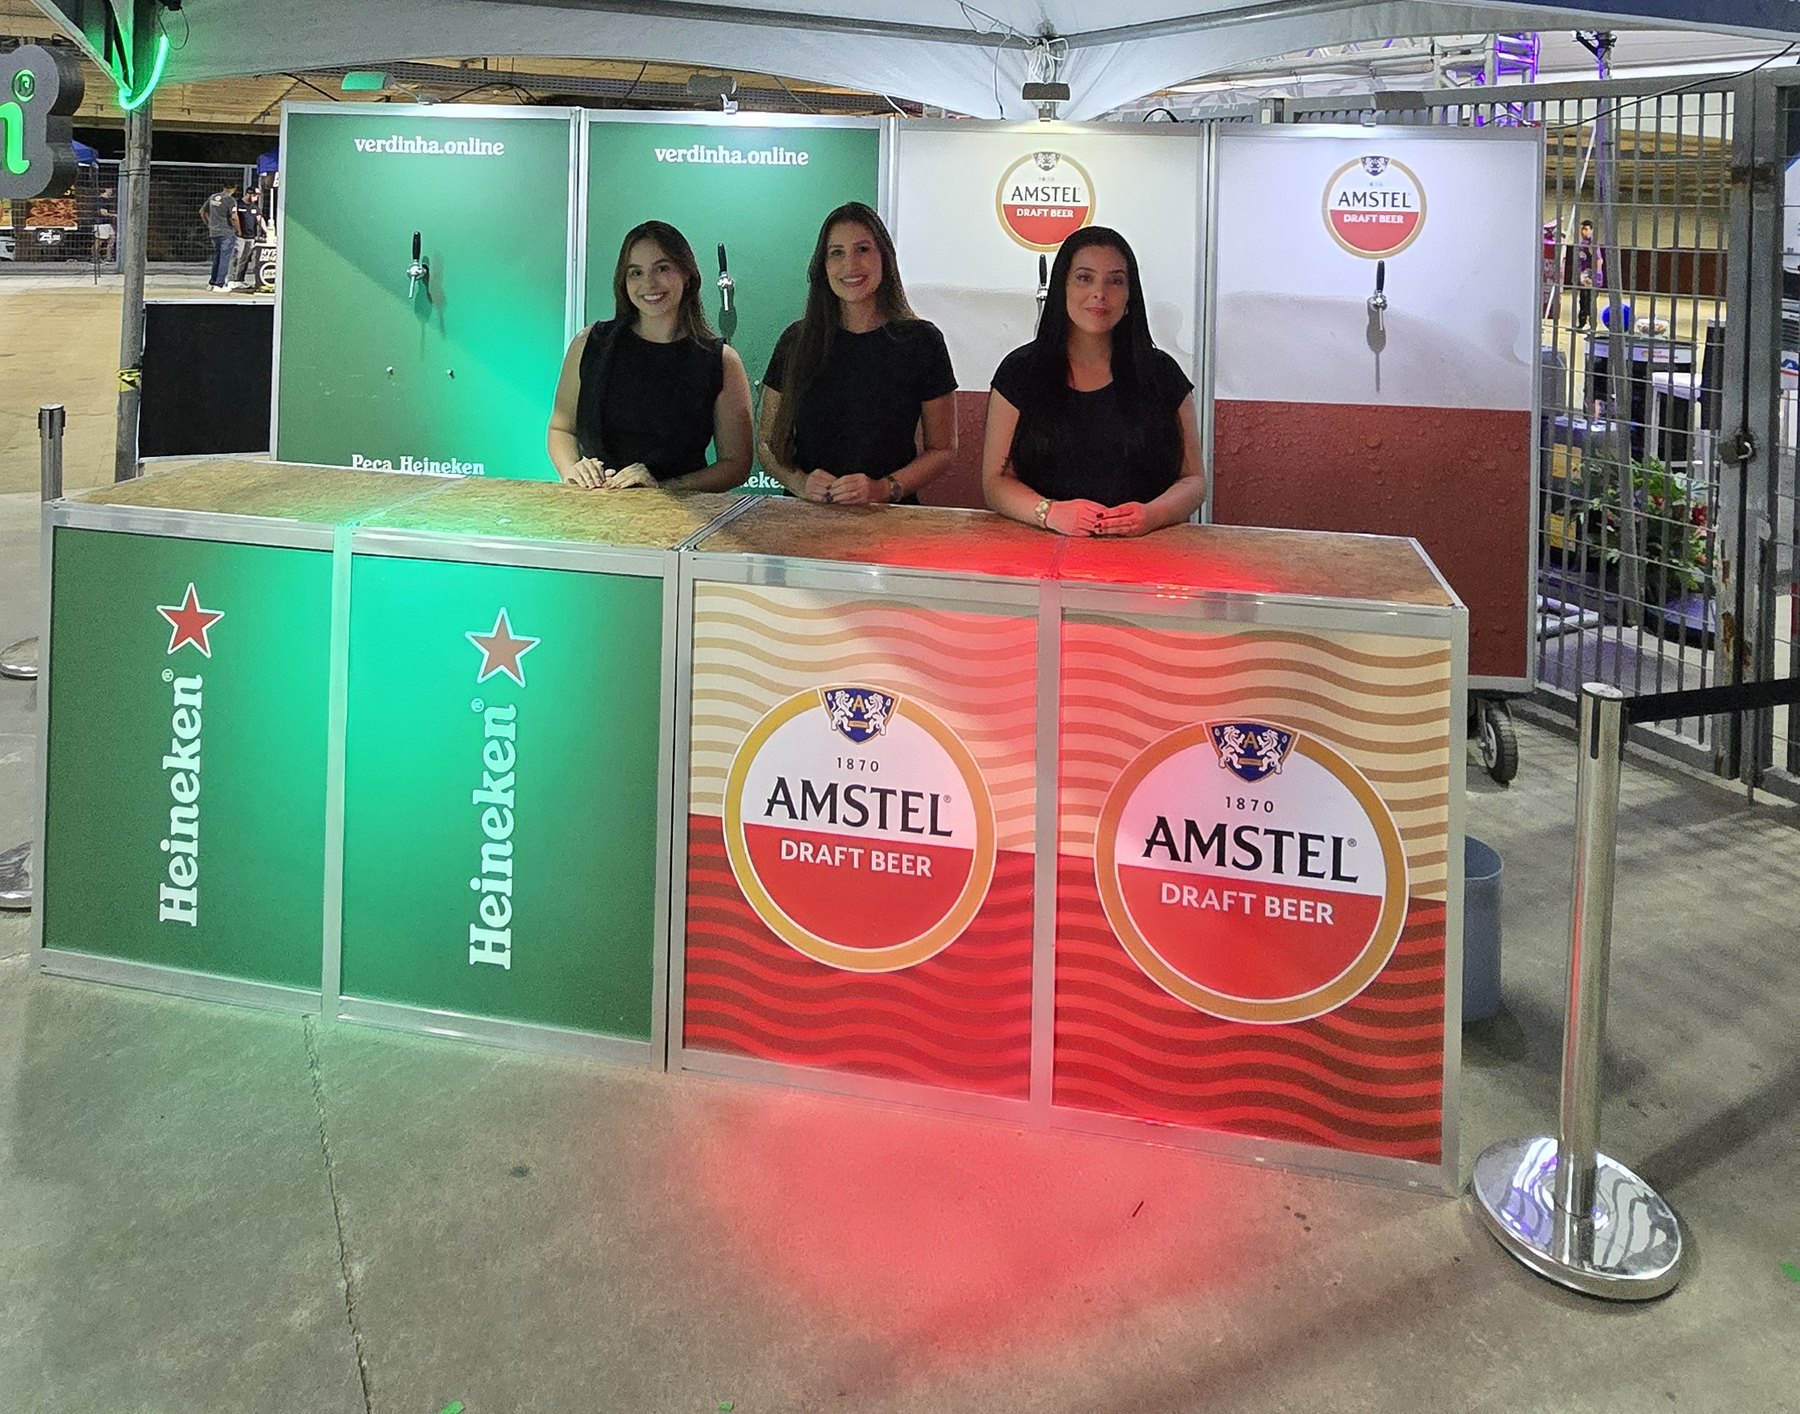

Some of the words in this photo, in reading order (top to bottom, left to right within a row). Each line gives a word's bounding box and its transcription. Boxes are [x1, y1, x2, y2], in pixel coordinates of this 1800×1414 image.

[354, 135, 504, 155] verdinha.online
[655, 145, 808, 165] verdinha.online
[1011, 186, 1080, 203] AMSTEL
[1338, 191, 1411, 208] AMSTEL
[1016, 208, 1049, 217] DRAFT
[1050, 209, 1074, 218] BEER
[1343, 214, 1378, 223] DRAFT
[1379, 214, 1404, 224] BEER
[400, 456, 485, 475] Heineken
[836, 756, 880, 773] 1870
[1224, 795, 1274, 813] 1870
[780, 839, 865, 869] DRAFT
[870, 850, 932, 878] BEER
[1160, 882, 1257, 915] DRAFT
[1264, 895, 1335, 926] BEER
